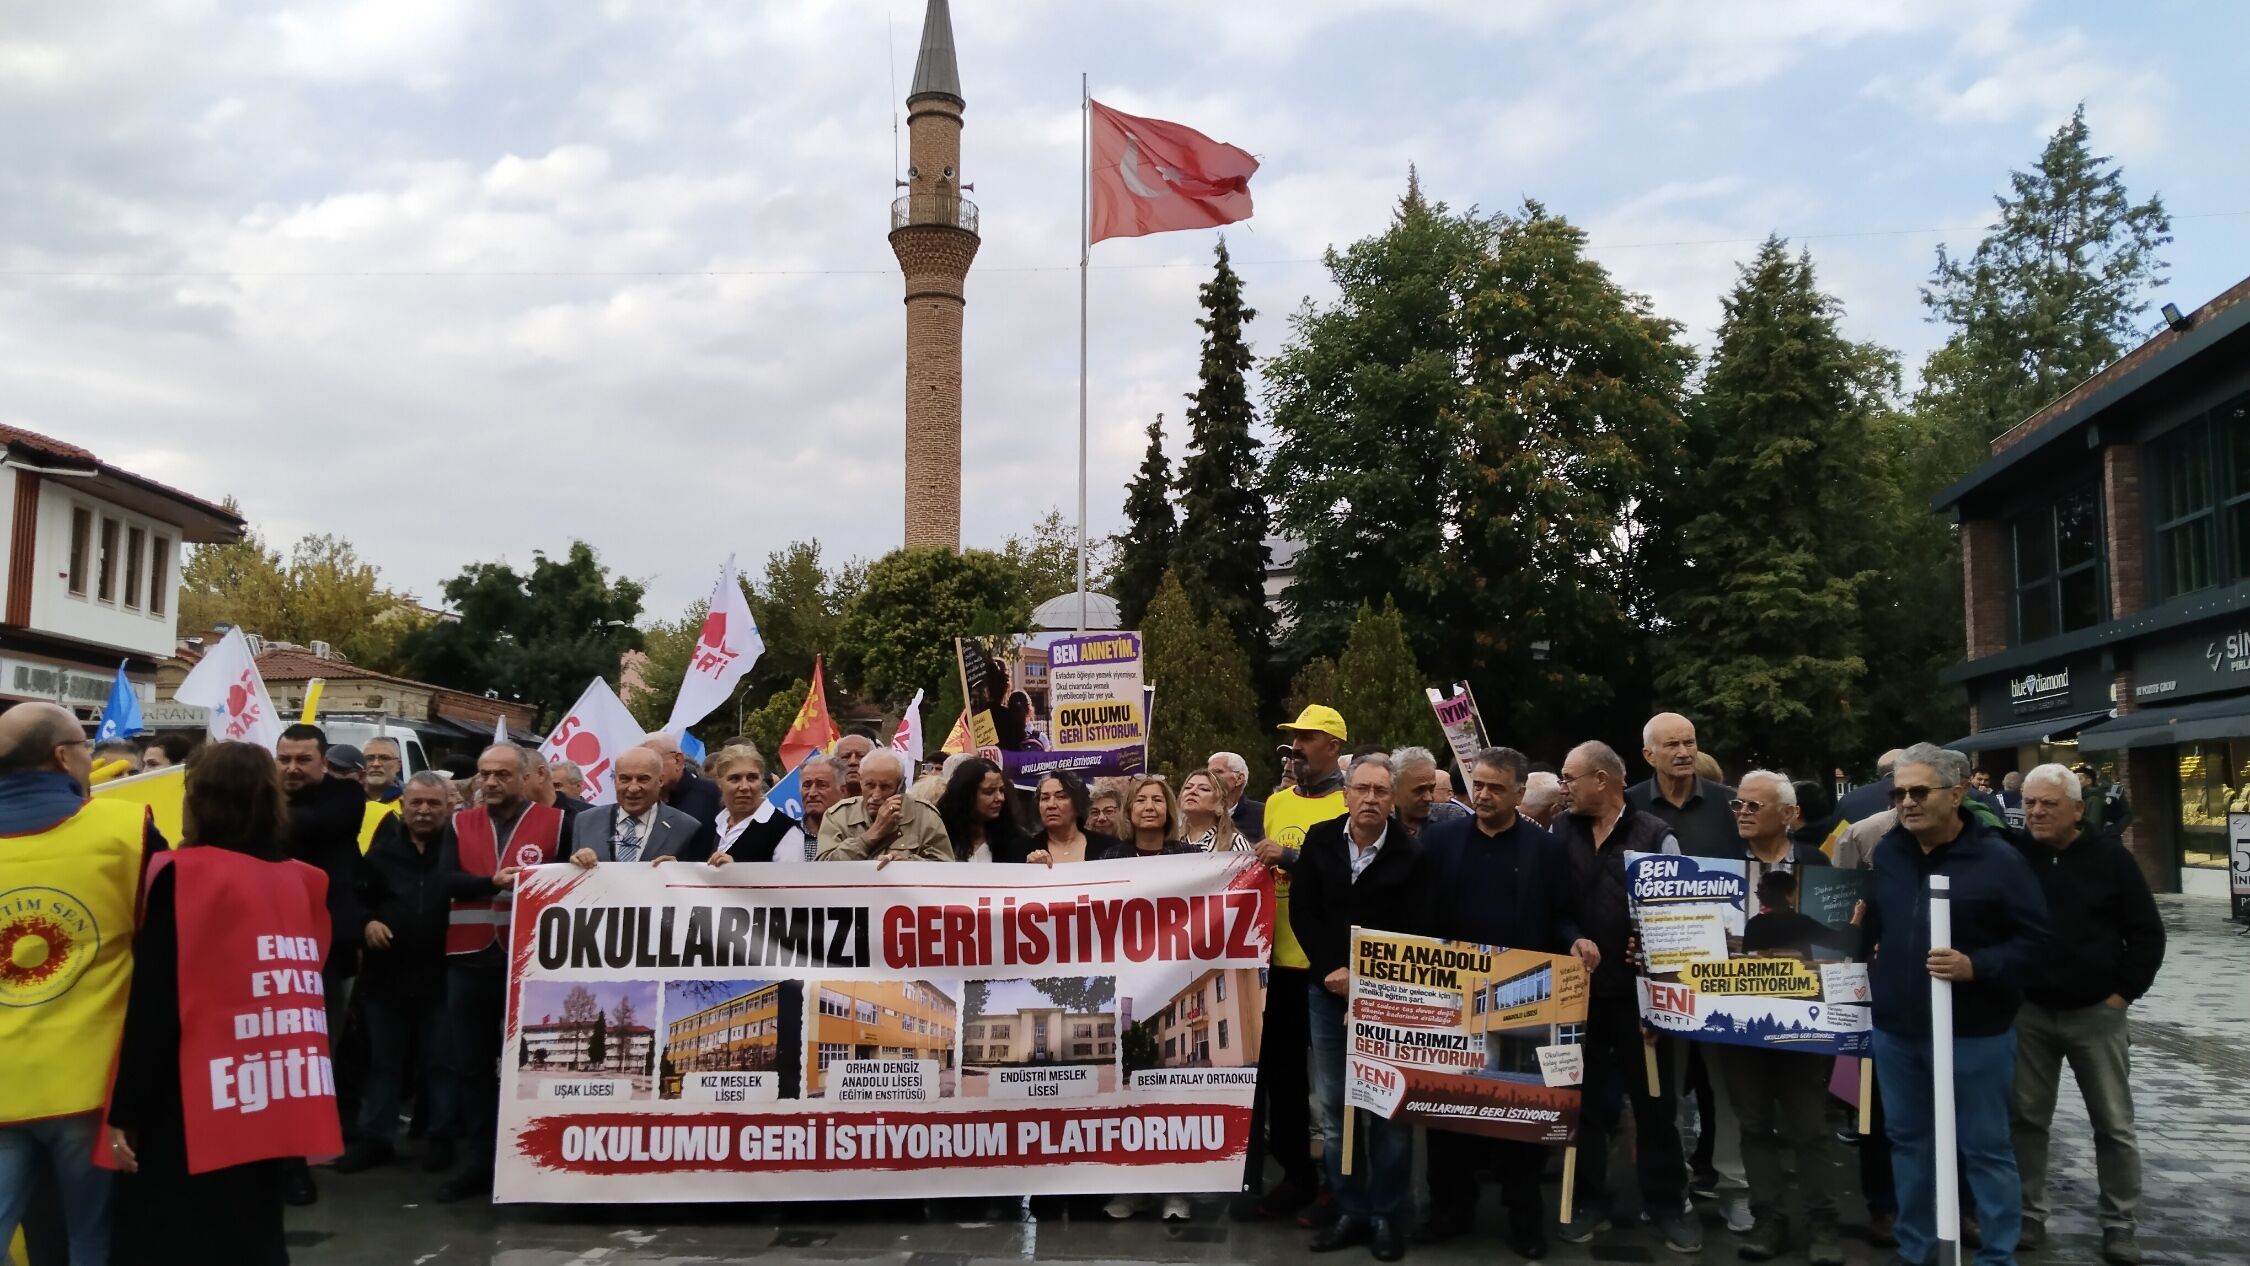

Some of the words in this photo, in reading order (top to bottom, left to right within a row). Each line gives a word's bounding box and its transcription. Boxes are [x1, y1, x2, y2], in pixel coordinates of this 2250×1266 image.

[1053, 643, 1078, 664] BEN
[1080, 637, 1136, 661] ANNEYİM.
[2011, 679, 2027, 697] blue
[2036, 666, 2069, 692] diamond
[1060, 704, 1130, 727] OKULUMU
[1060, 725, 1083, 744] GERİ
[1086, 722, 1142, 742] İSTİYORUM.
[1639, 860, 1679, 879] BEN
[2235, 873, 2250, 885] İN
[1634, 876, 1744, 897] ÖĞRETMENİM.
[538, 906, 871, 970] OKULLARIMIZI
[883, 896, 992, 969] GERİ
[1003, 893, 1261, 964] İSTİYORUZ
[1360, 941, 1397, 961] BEN
[1402, 945, 1491, 973] ANADOLU
[1360, 959, 1462, 989] LİSELİYİM.
[1691, 962, 1793, 979] OKULLARIMIZI
[1360, 979, 1376, 989] Daha
[1399, 985, 1408, 994] bir
[1439, 990, 1451, 1000] için
[1700, 978, 1730, 993] GERİ
[1735, 976, 1815, 992] İSTİYORUM.
[1385, 991, 1408, 1002] eğitim
[1355, 1023, 1468, 1050] OKULLARIMIZI
[1355, 1037, 1390, 1057] GERİ
[1395, 1041, 1488, 1068] İSTİYORUM.
[846, 1063, 880, 1074] ORHAN
[883, 1061, 919, 1074] DENGİZ
[1000, 1068, 1047, 1083] ENDÜSTRİ
[1050, 1069, 1087, 1081] MESLEK
[1352, 1061, 1395, 1090] YENİ
[554, 1084, 581, 1099] UŞAK
[583, 1081, 614, 1097] LİSESİ
[701, 1076, 718, 1088] KIZ
[720, 1075, 762, 1088] MESLEK
[842, 1076, 889, 1088] ANADOLU
[892, 1074, 922, 1087] LİSESİ
[1138, 1073, 1167, 1086] BESİM
[1170, 1073, 1204, 1085] ATALAY
[715, 1088, 745, 1101] LİSESİ
[1028, 1084, 1058, 1097] LİSESİ
[1406, 1101, 1477, 1115] OKULLARIMIZI
[1479, 1106, 1506, 1117] GERİ
[1507, 1107, 1560, 1122] İSTİYORUZ
[562, 1126, 731, 1161] OKULUMU
[740, 1118, 816, 1161] GERİ
[826, 1117, 1007, 1160] İSTİYORUM
[1018, 1115, 1225, 1155] PLATFORMU
